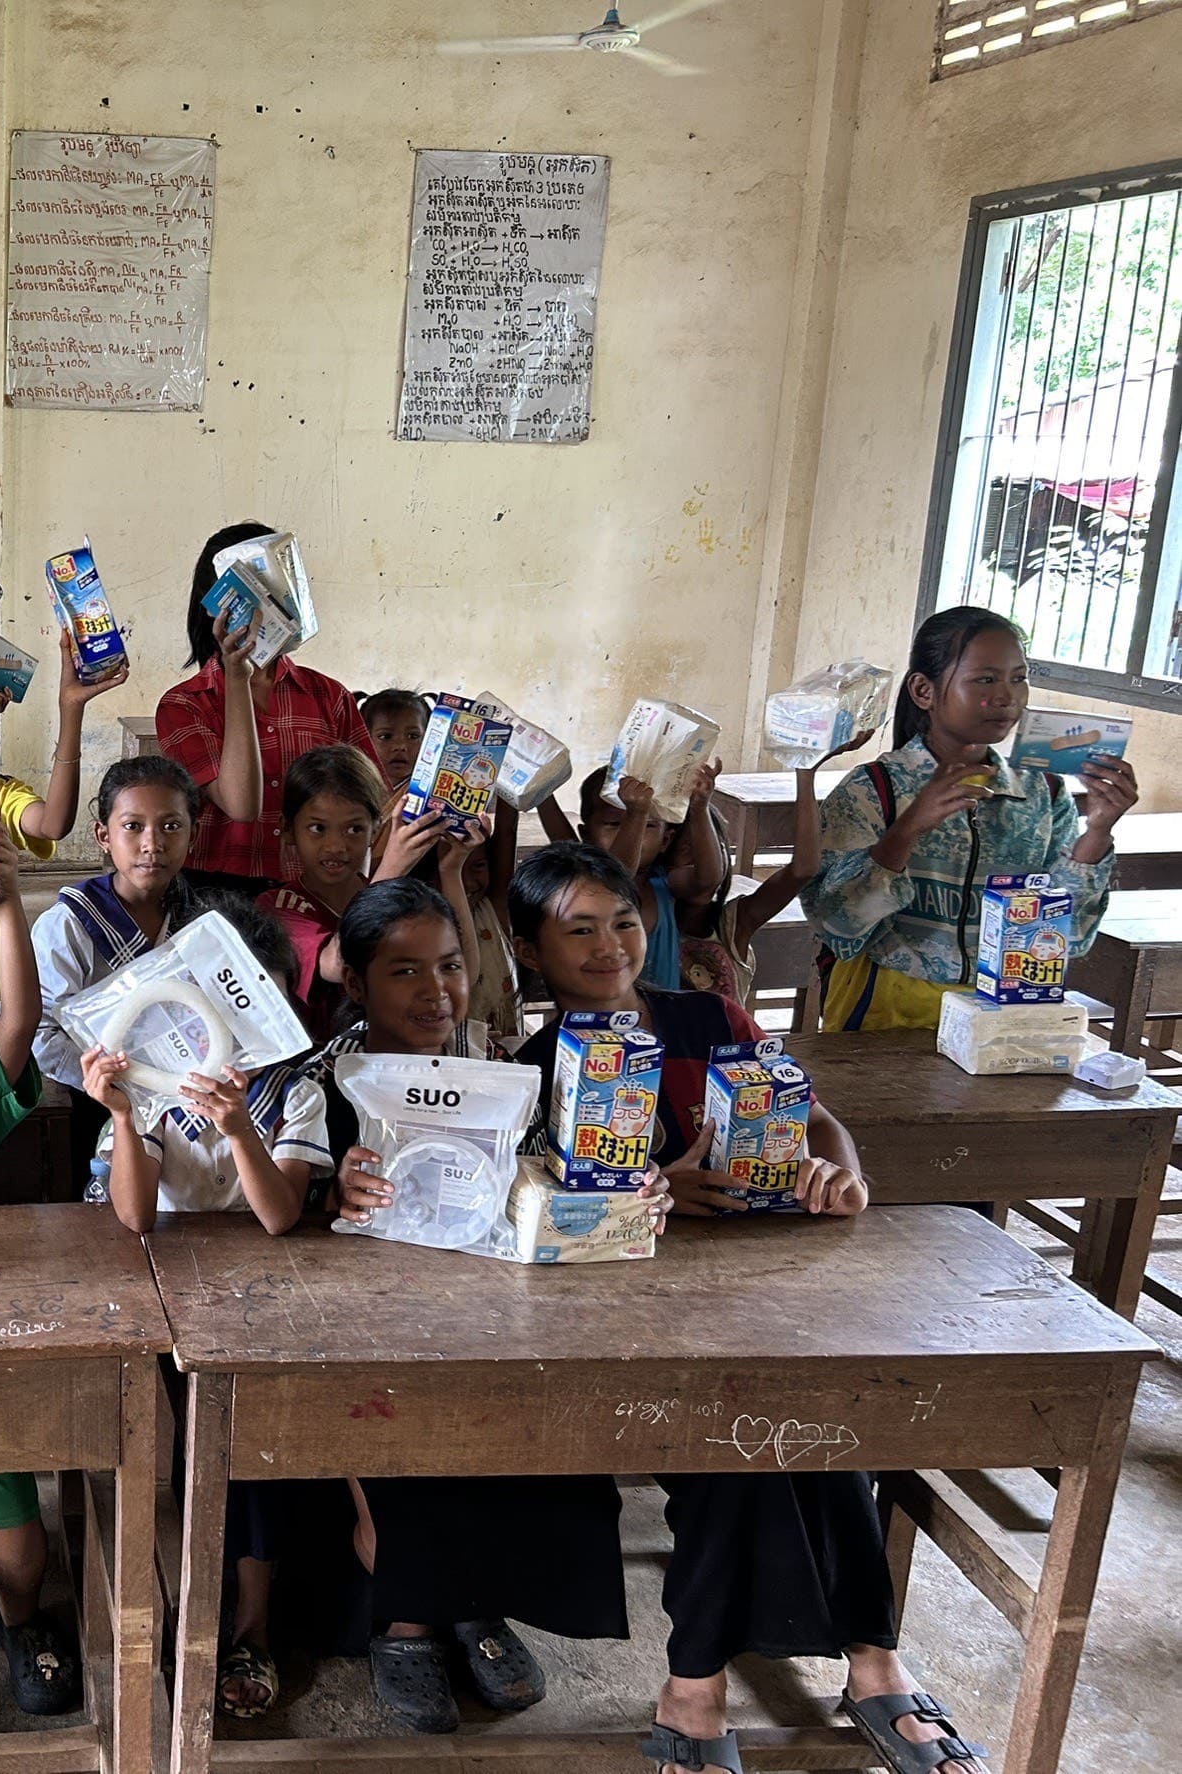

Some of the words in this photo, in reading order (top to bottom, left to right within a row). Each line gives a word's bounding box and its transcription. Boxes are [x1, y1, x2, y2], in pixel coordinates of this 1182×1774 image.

[52, 557, 76, 578] No.1
[452, 722, 484, 741] No.1
[434, 772, 488, 813] 熱さまシート
[1007, 900, 1039, 918] No.1
[1005, 954, 1061, 982] 熱さまシート
[217, 968, 251, 1009] SUO
[168, 1031, 189, 1058] SUO
[585, 1050, 624, 1073] No.1
[405, 1088, 461, 1107] SUO
[736, 1090, 772, 1112] No.1
[576, 1129, 646, 1167] 熱さまシート
